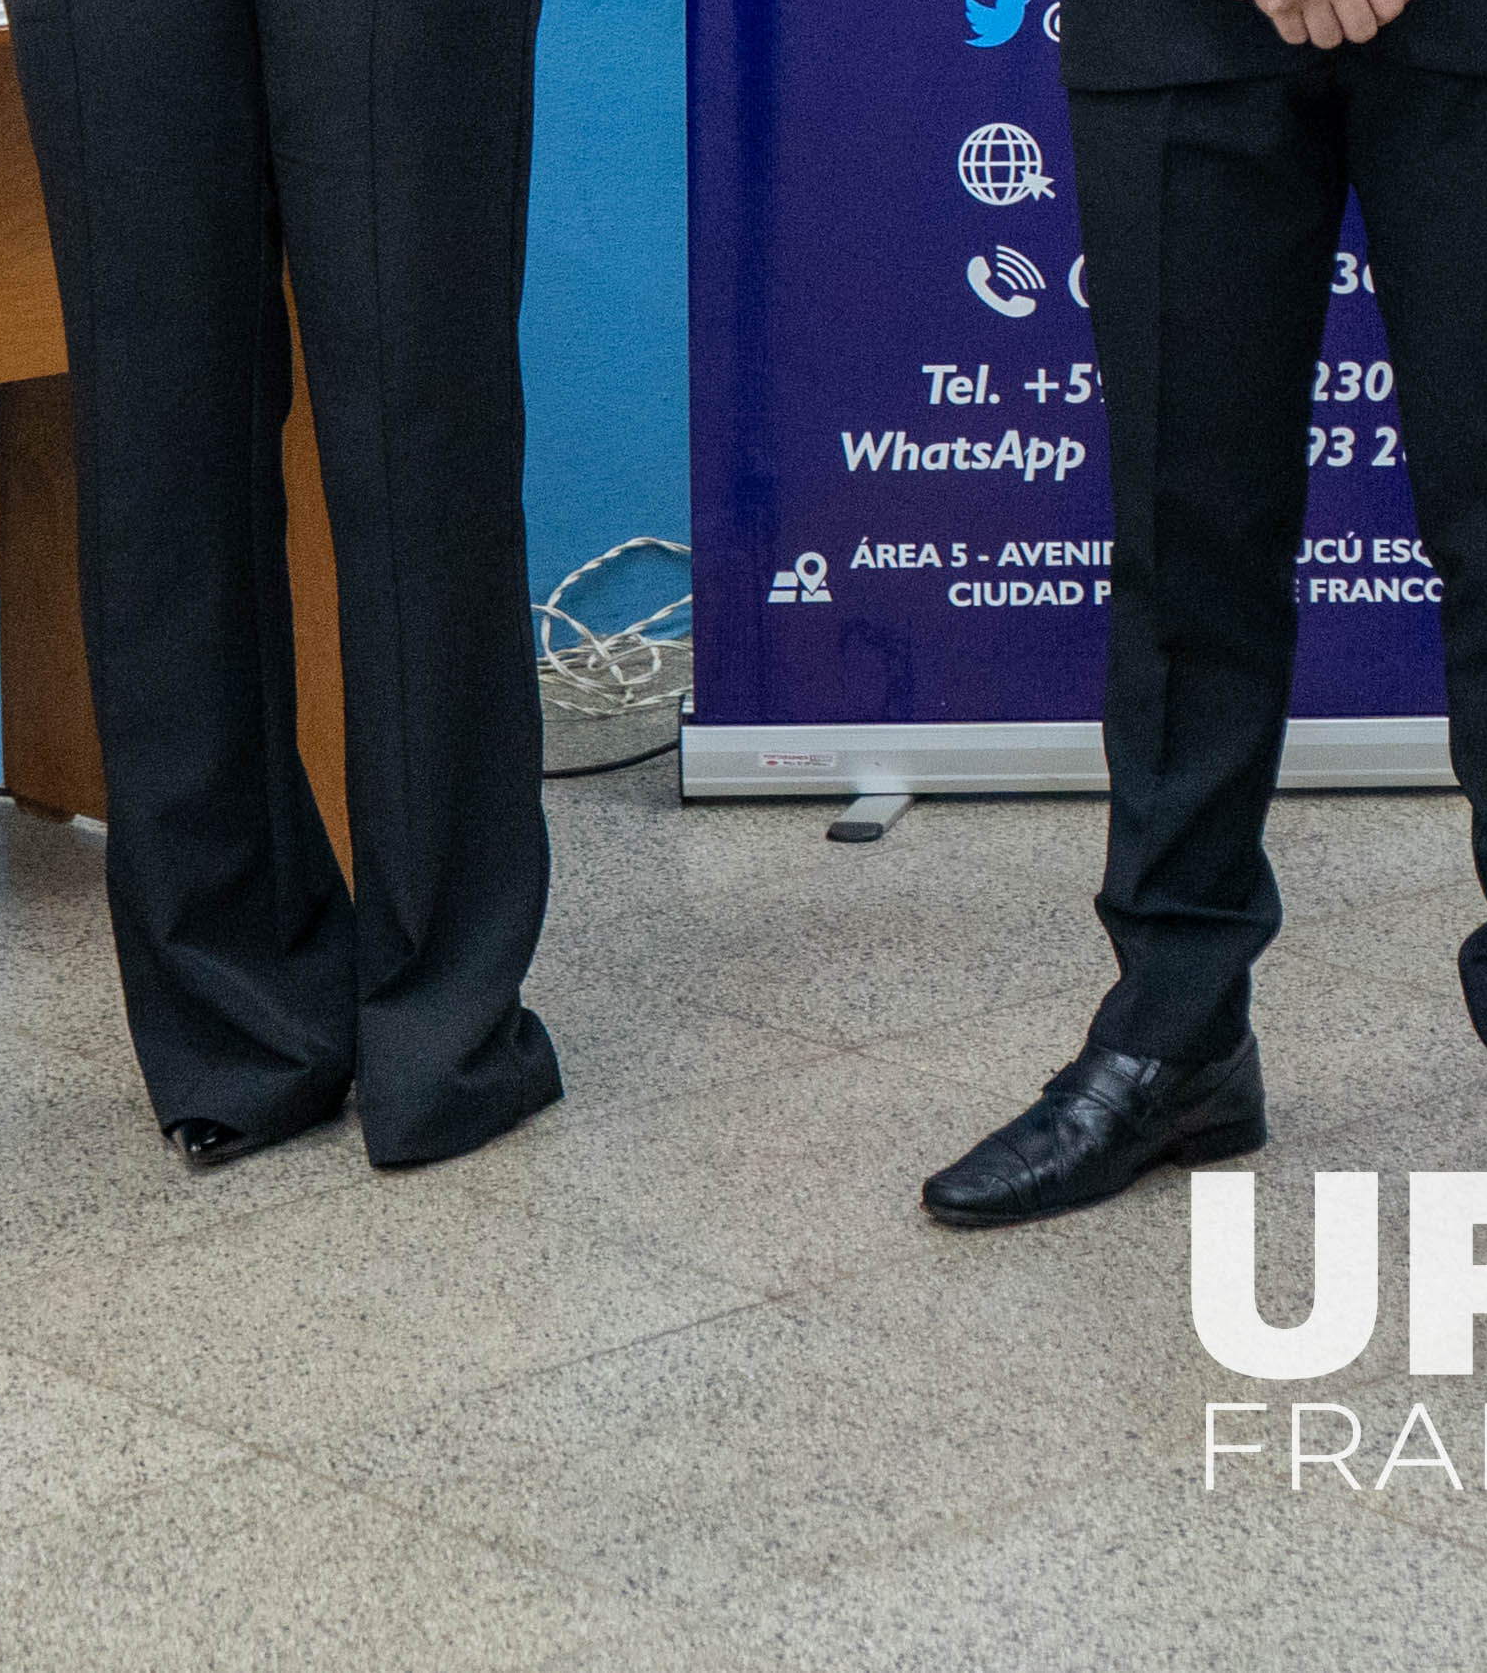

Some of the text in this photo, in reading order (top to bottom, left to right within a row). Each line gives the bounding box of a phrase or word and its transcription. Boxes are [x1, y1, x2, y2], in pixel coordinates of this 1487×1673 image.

[922, 365, 1000, 404] Tel.
[842, 430, 1085, 481] WhatsApp
[851, 537, 938, 568] ÁREA
[951, 543, 967, 567] 5
[949, 581, 1084, 607] CIUDAD
[1310, 578, 1443, 602] FRANCO
